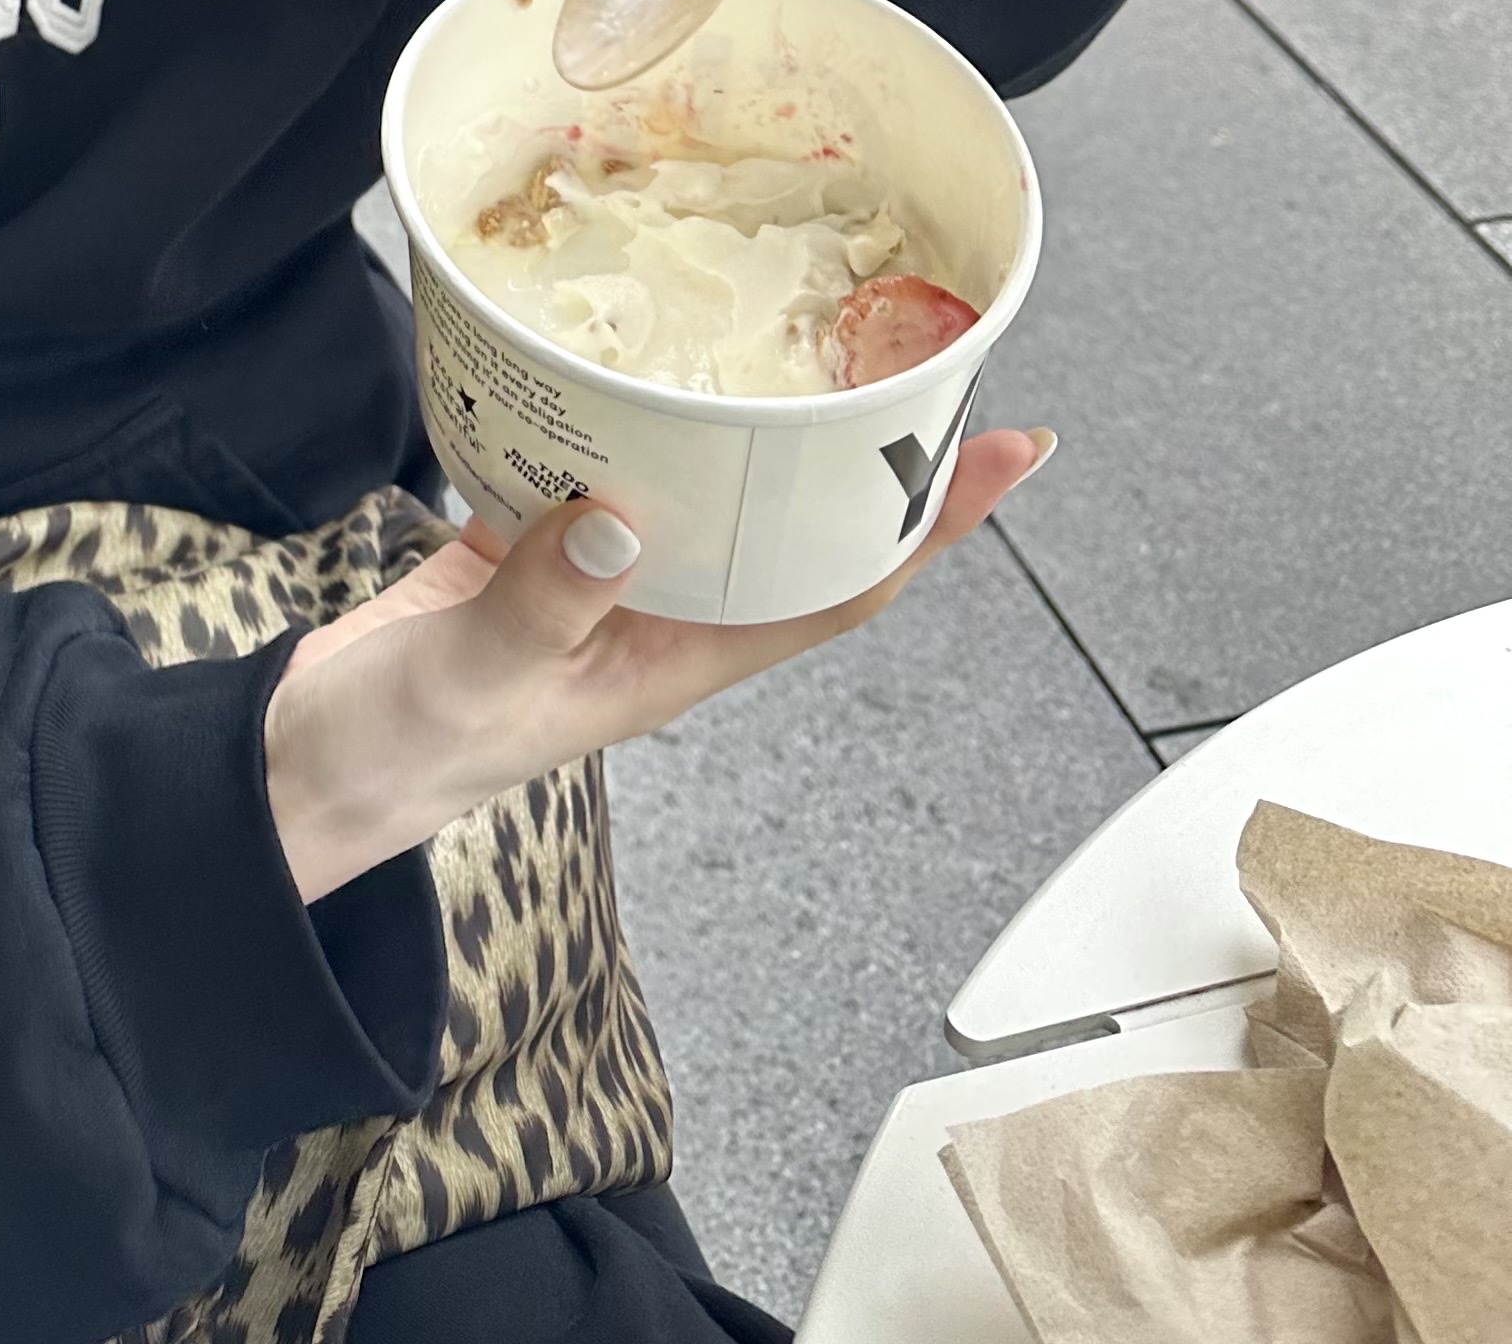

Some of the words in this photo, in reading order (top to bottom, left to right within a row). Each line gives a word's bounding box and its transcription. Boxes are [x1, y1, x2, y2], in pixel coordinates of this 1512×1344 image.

[473, 326, 497, 358] long
[502, 352, 528, 381] long
[533, 376, 562, 399] way
[474, 345, 488, 362] on
[502, 370, 536, 399] every
[540, 396, 566, 416] day
[471, 368, 486, 387] for
[489, 385, 514, 411] your
[517, 410, 609, 464] co-operation
[502, 385, 518, 401] an
[521, 399, 593, 443] obligation
[503, 447, 553, 500] THING
[511, 448, 563, 494] RIGHT
[539, 462, 570, 491] THE
[561, 469, 589, 493] DO
